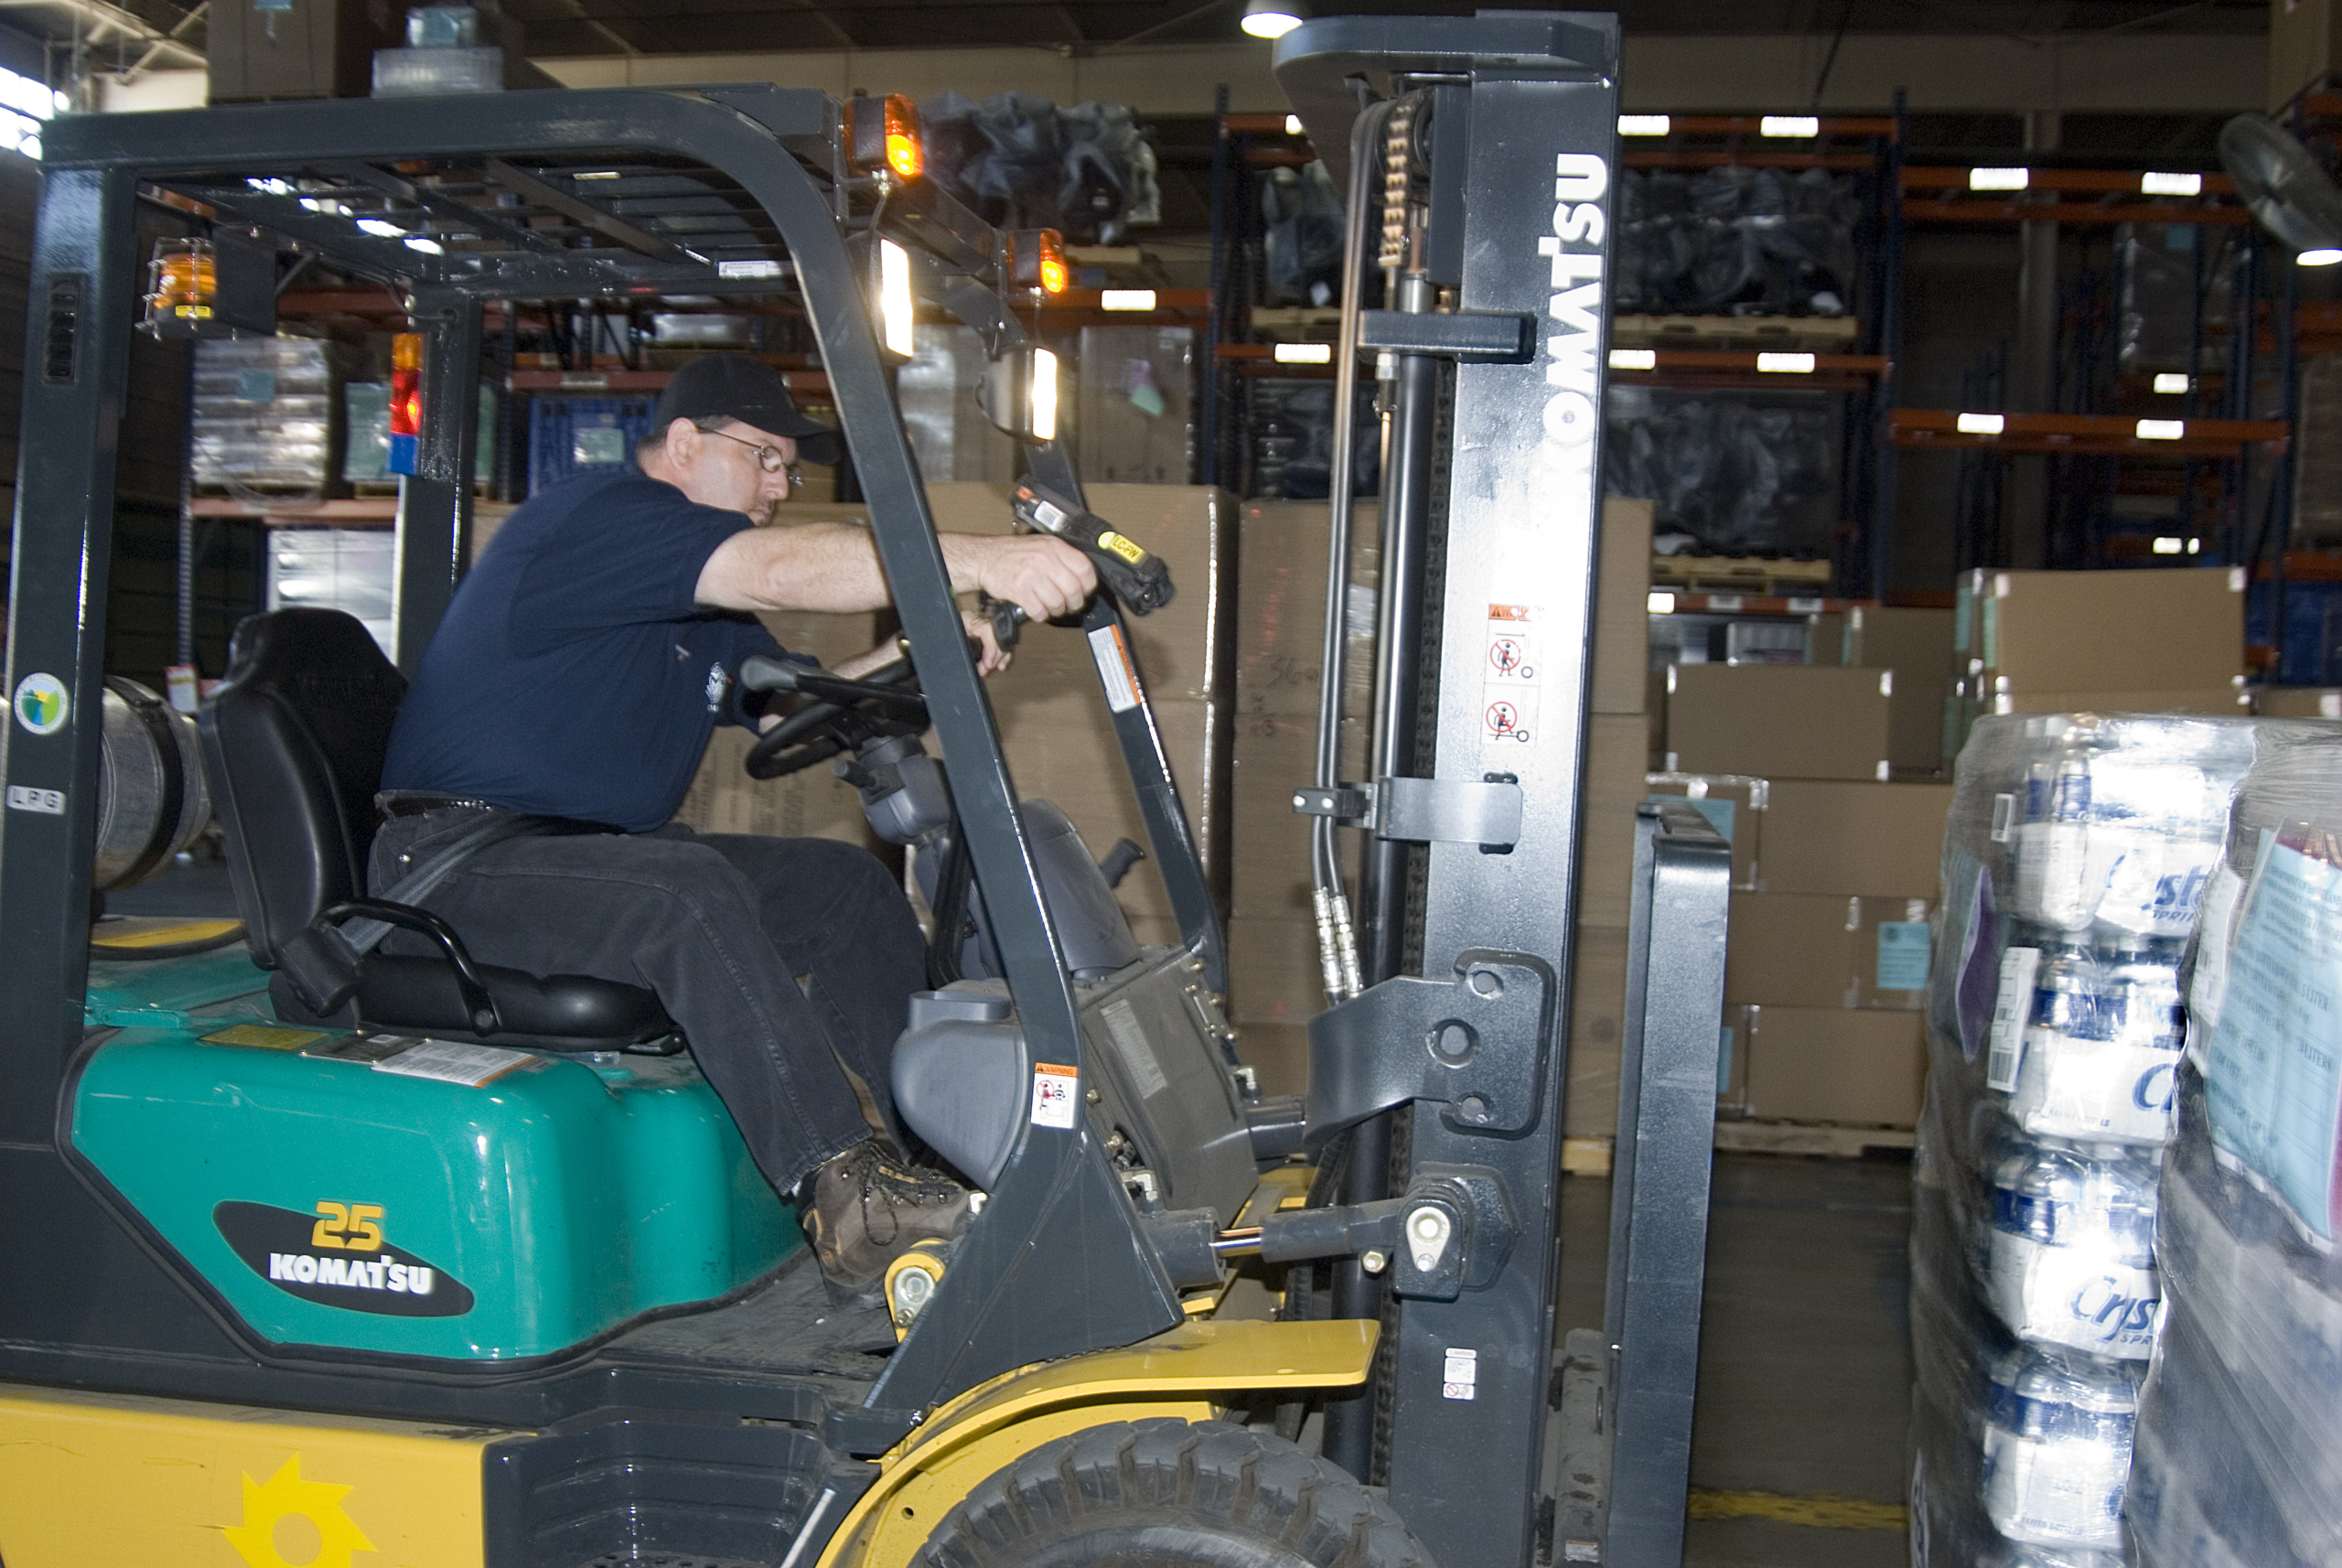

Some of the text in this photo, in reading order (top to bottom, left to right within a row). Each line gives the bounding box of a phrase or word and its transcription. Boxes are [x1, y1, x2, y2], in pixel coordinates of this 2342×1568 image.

[1538, 153, 1606, 490] OMATSU
[1112, 536, 1140, 558] LC-FW
[13, 788, 59, 808] LPG
[1045, 1065, 1073, 1076] WARNING
[311, 1201, 382, 1251] 25
[269, 1252, 433, 1295] KOMATSU
[2069, 1276, 2161, 1341] Crys
